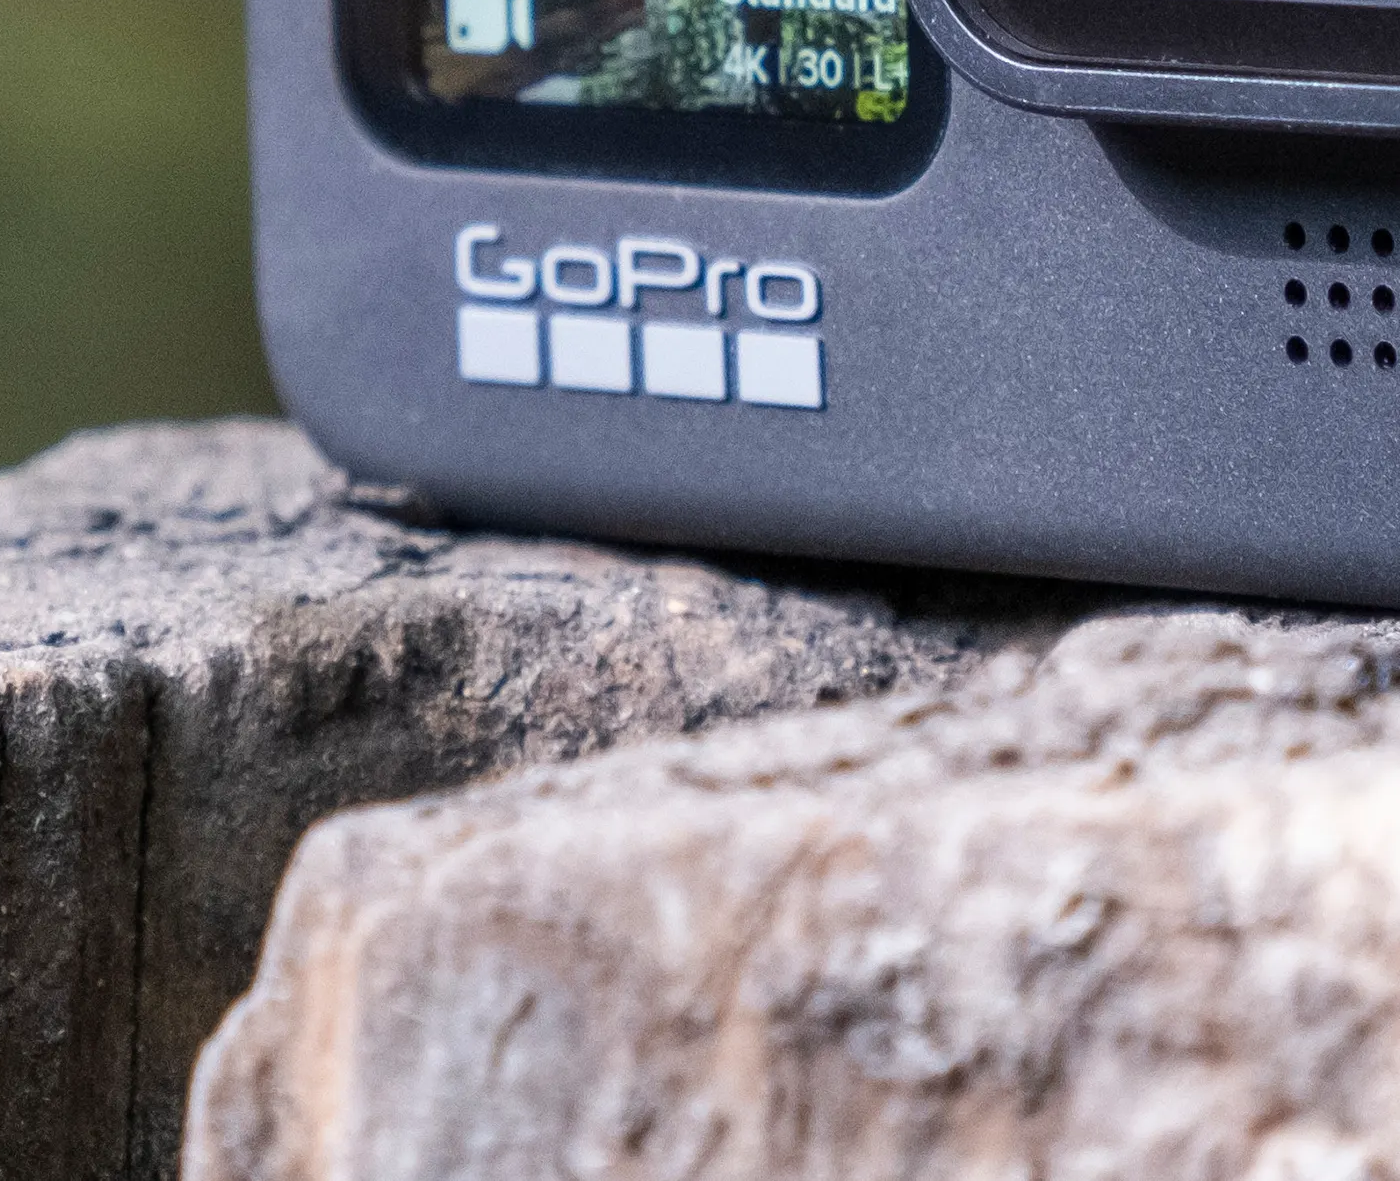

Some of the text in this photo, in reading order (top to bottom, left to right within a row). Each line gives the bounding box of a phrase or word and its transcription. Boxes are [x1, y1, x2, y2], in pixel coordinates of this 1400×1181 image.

[723, 45, 770, 84] 4K
[798, 48, 844, 88] 30
[457, 224, 818, 320] GoPro
